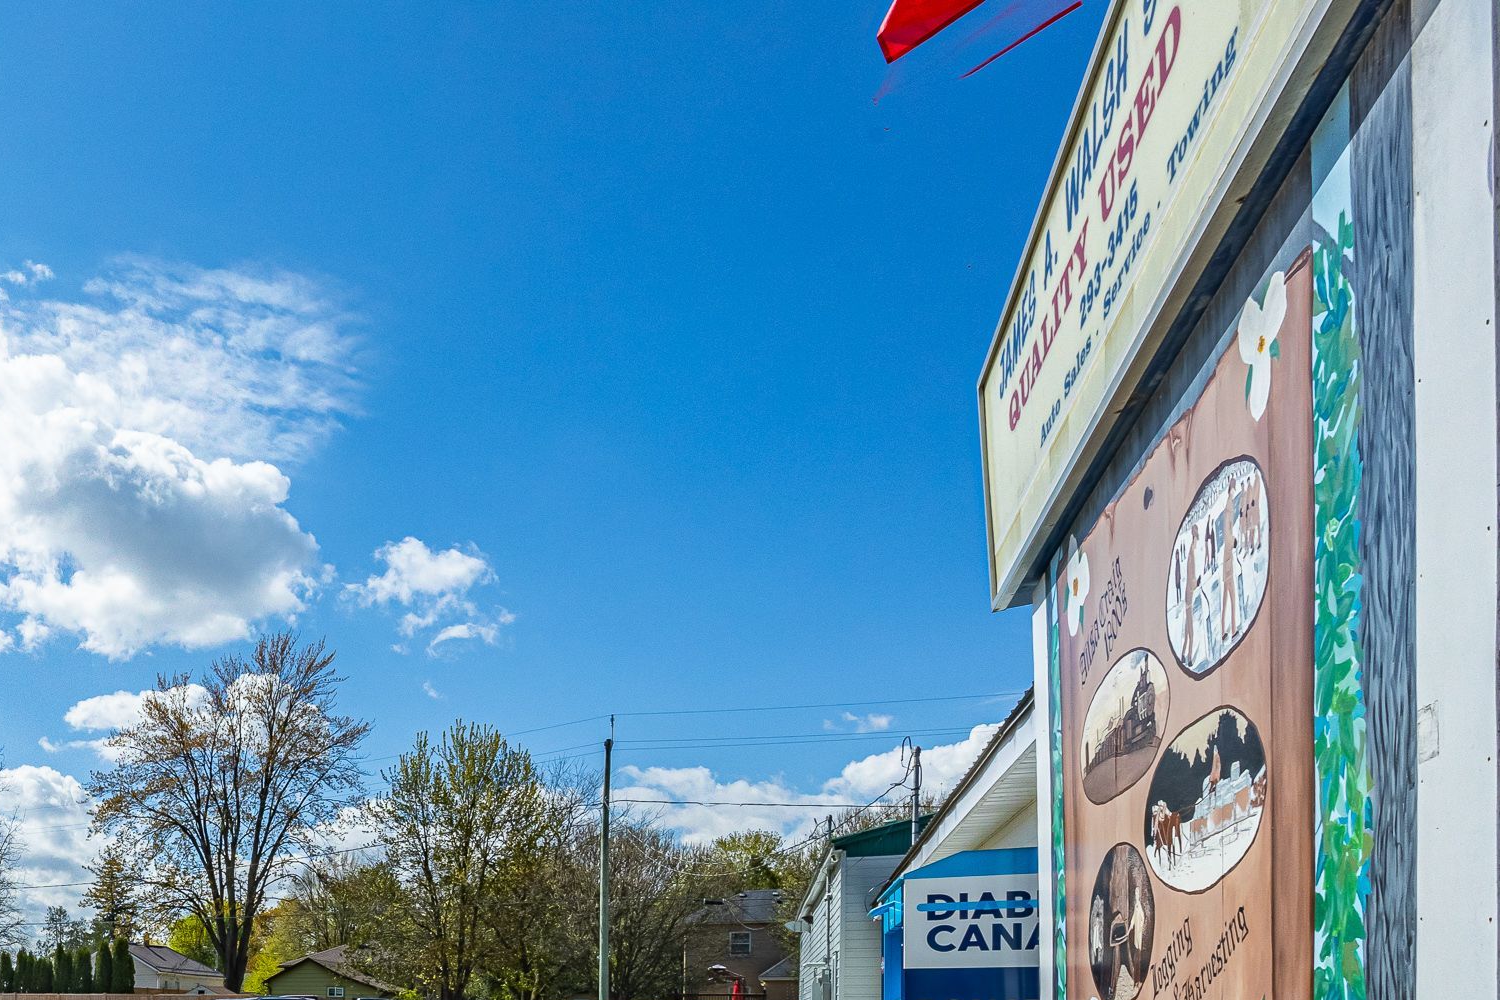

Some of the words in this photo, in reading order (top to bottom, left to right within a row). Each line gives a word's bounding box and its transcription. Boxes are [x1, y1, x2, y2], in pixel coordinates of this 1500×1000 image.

[999, 269, 1037, 399] JAMES
[1043, 229, 1058, 291] A.
[1065, 18, 1128, 233] WALSH
[1008, 216, 1090, 432] QUALITY
[1098, 5, 1182, 223] USED
[1039, 398, 1061, 448] Auto
[1063, 336, 1092, 399] Sales
[1102, 211, 1151, 320] Service
[1167, 26, 1238, 185] Towing
[1079, 177, 1138, 330] 293-3415
[926, 890, 1039, 921] DIAB
